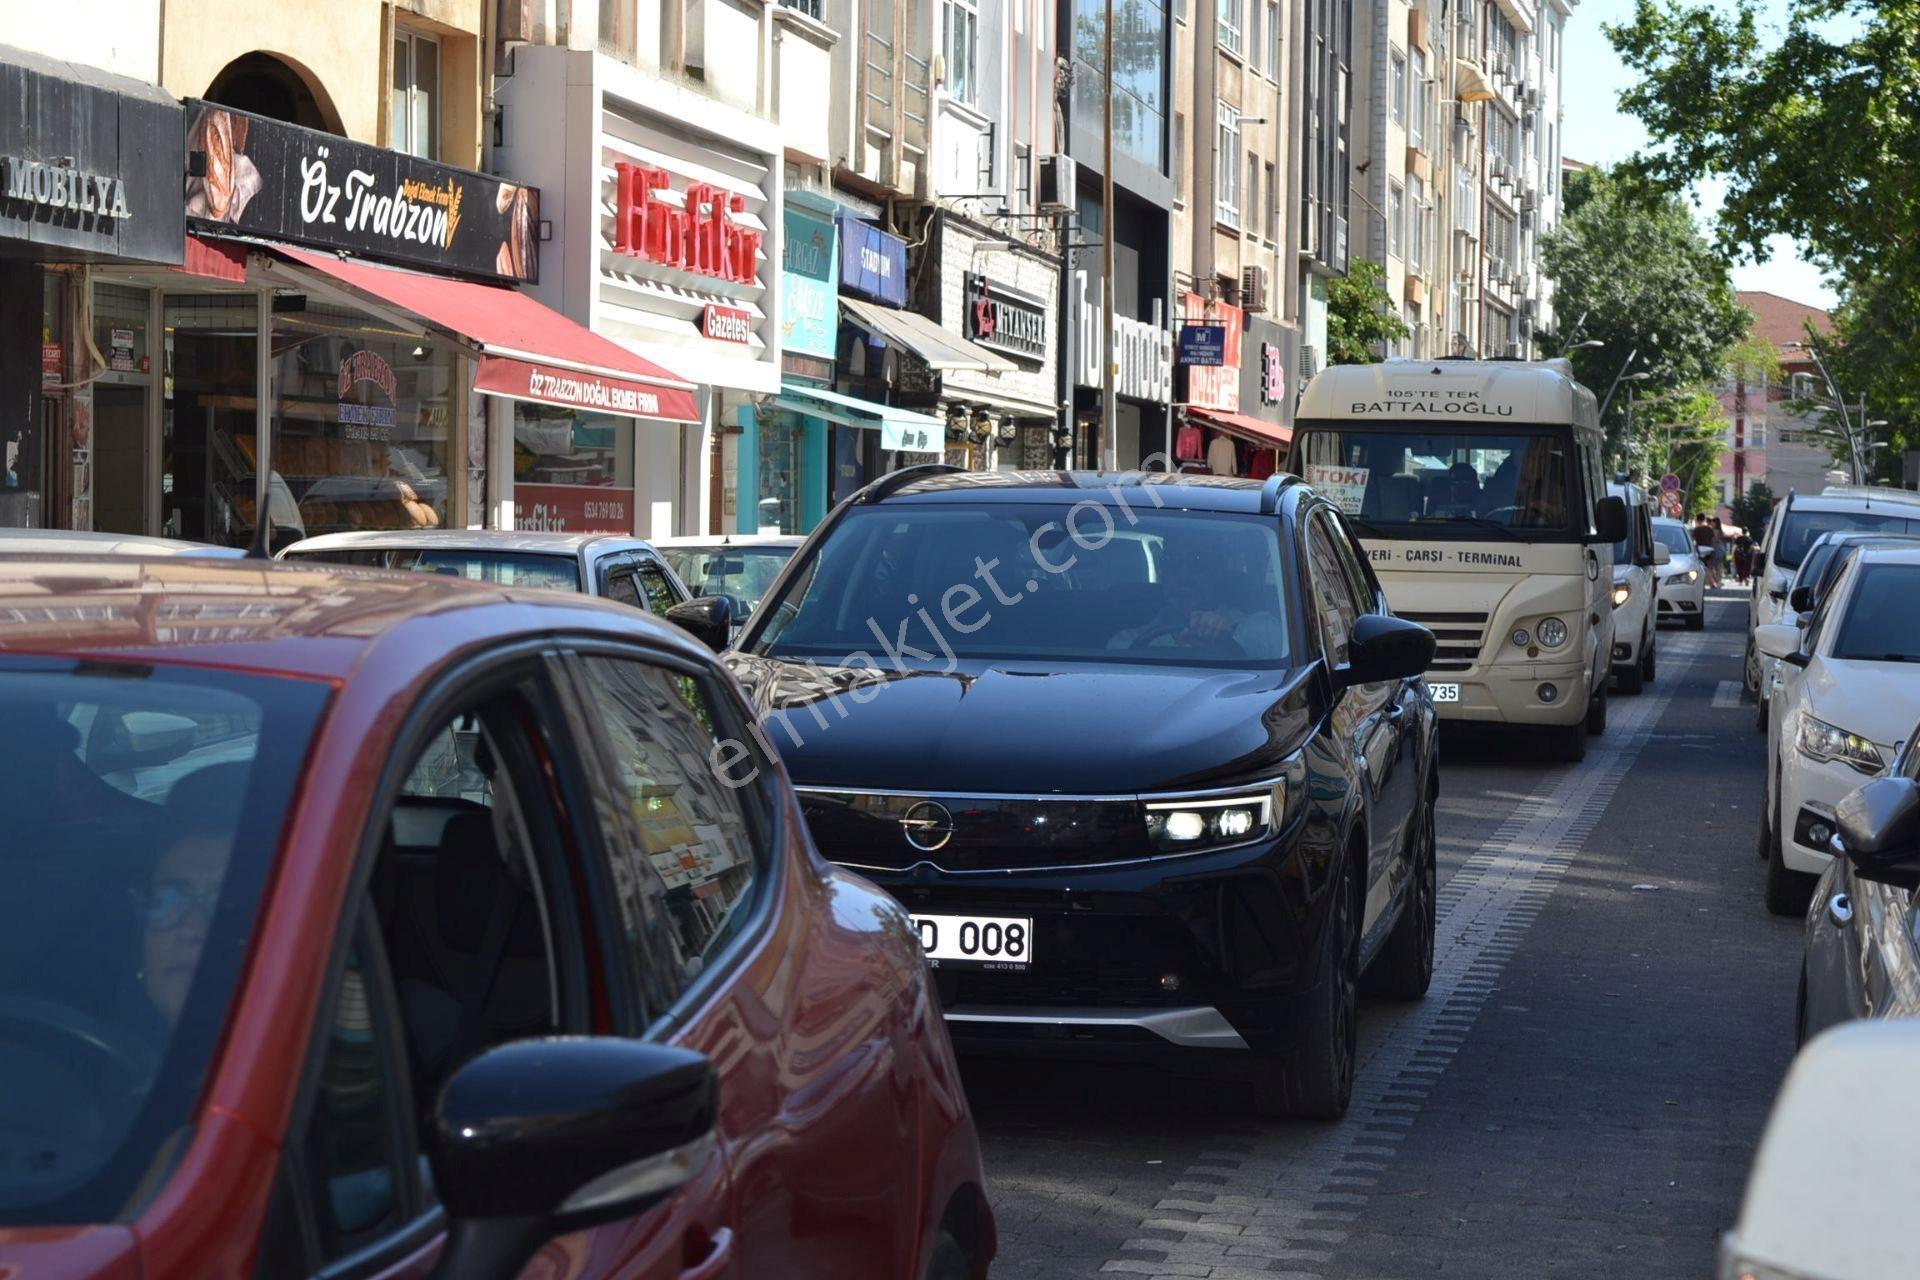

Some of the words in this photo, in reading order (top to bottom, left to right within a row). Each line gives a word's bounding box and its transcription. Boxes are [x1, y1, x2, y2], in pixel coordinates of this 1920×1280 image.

[8, 156, 132, 218] MOBİLYA
[301, 146, 341, 224] Öz
[345, 169, 448, 248] Trabzon
[707, 305, 750, 342] Gazetesi
[529, 368, 543, 396] ÖZ
[543, 375, 582, 402] TRABZON
[582, 379, 612, 407] DOĞAL
[611, 387, 638, 411] EKMEK
[1386, 389, 1440, 399] 105'TE
[1446, 390, 1480, 399] TEK
[1351, 401, 1513, 417] BATTALOĞLU
[584, 501, 598, 519] 0534
[1364, 549, 1391, 561] YERİ
[1406, 550, 1443, 562] ÇARŞI
[1430, 685, 1457, 700] 735
[959, 921, 1025, 957] 008
